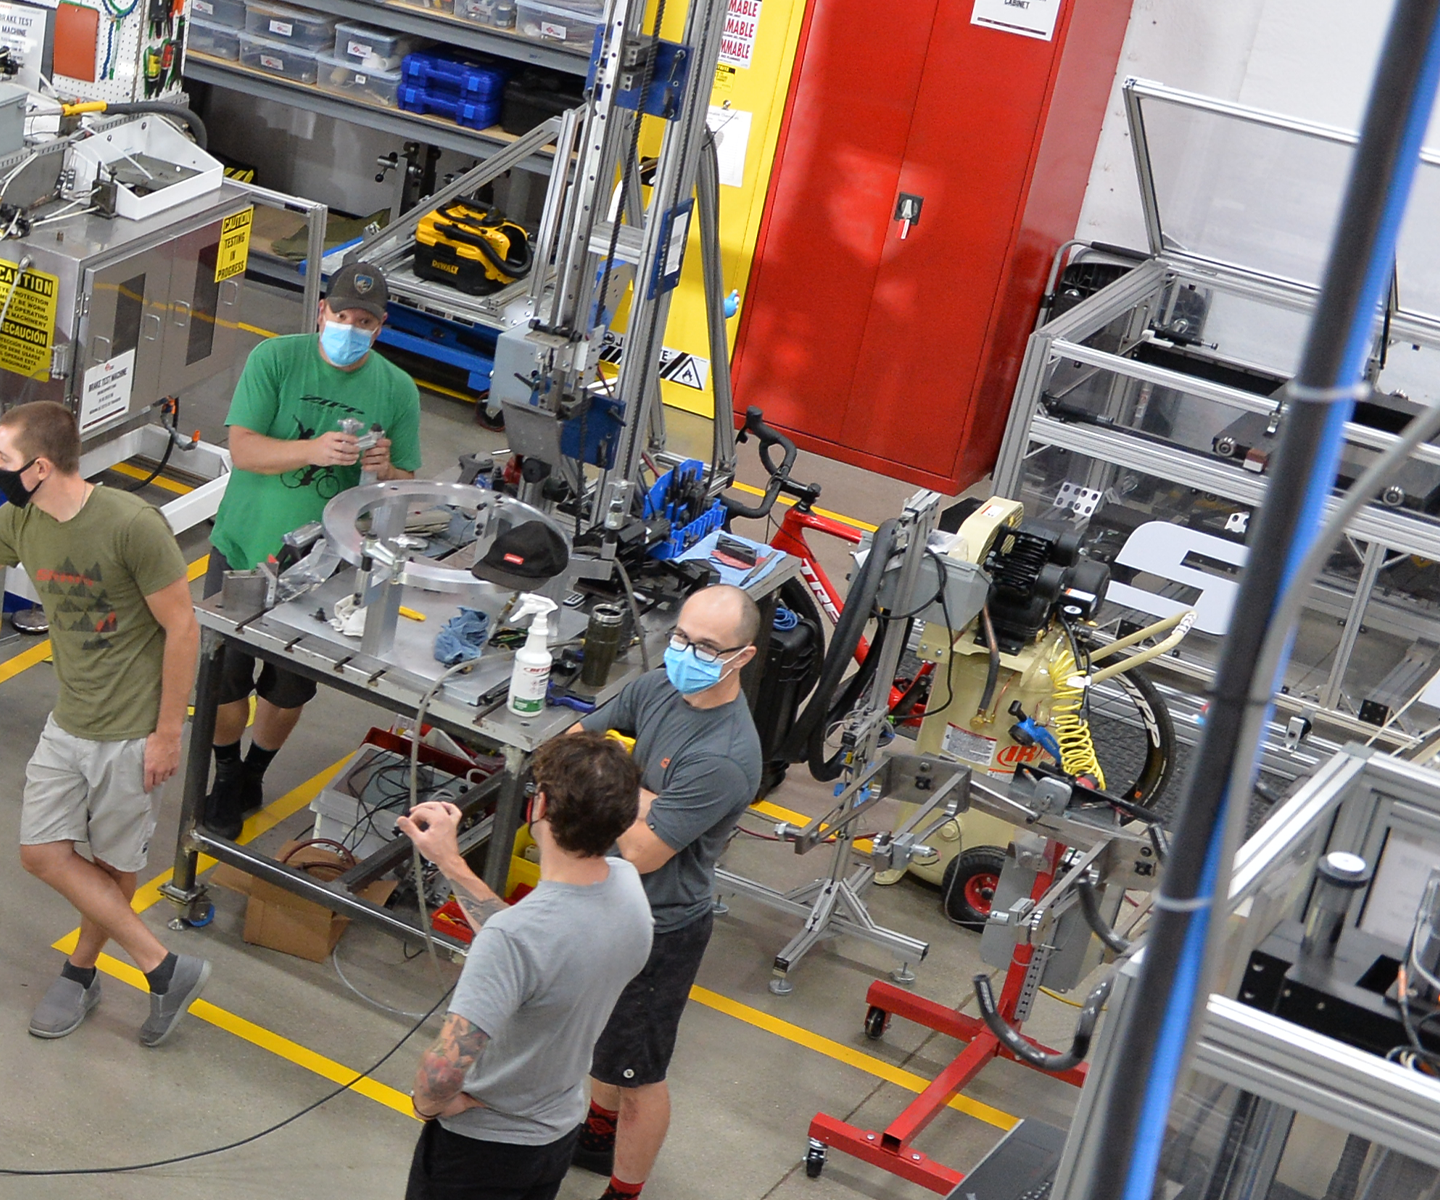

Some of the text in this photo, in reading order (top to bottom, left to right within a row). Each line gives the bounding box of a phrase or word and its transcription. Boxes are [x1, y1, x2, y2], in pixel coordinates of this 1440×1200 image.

[728, 0, 758, 17] MABLE
[19, 17, 33, 27] TEST
[2, 25, 27, 37] MACHINE
[224, 232, 245, 249] TESTING
[217, 260, 244, 281] PROGRESS
[13, 289, 49, 306] PROTECTION
[14, 305, 49, 321] OPERATING
[28, 302, 46, 313] WORN
[11, 312, 47, 328] MACHINERY
[801, 558, 840, 625] TRE
